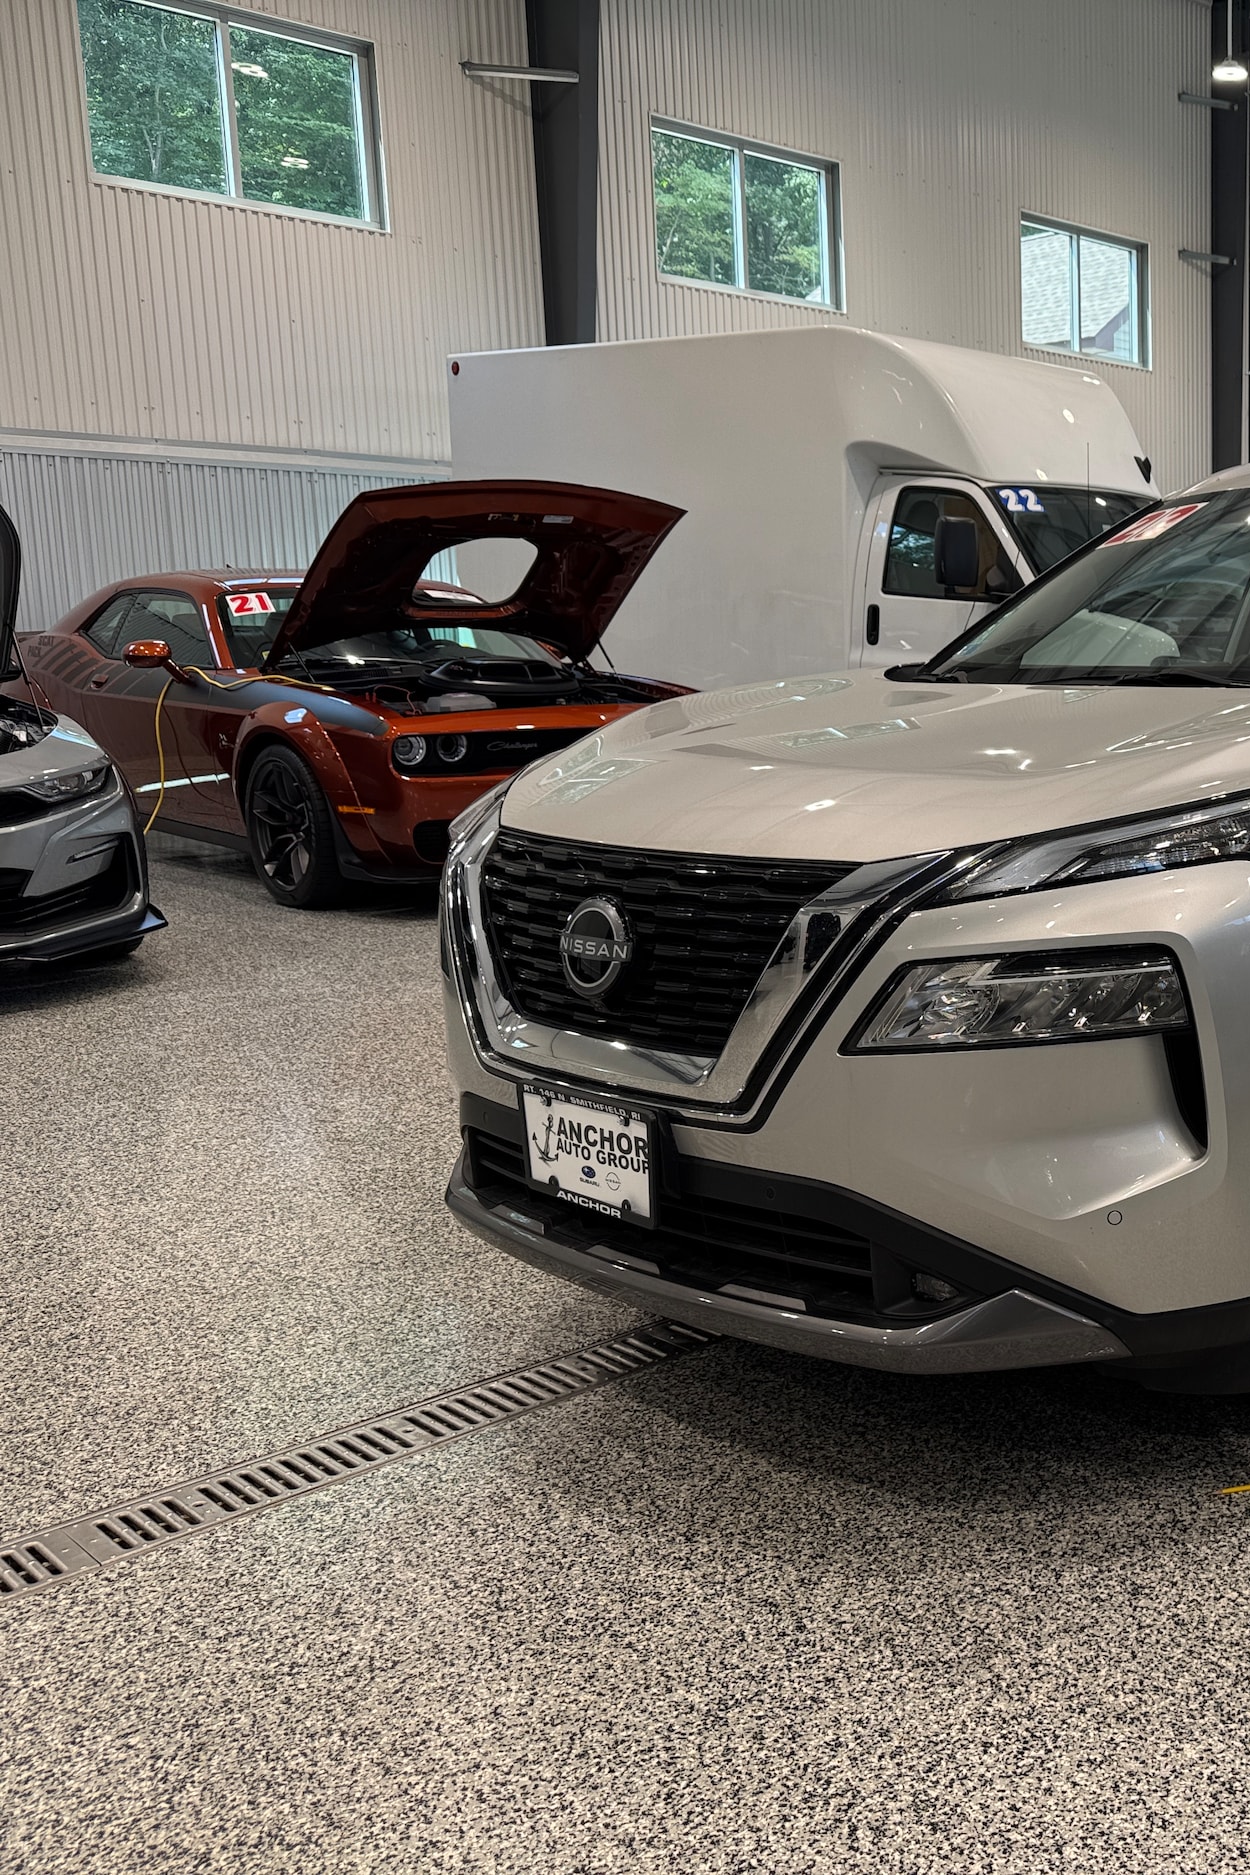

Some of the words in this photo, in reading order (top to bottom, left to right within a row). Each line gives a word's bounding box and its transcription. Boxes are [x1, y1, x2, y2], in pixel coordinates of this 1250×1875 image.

[999, 488, 1045, 512] 22
[229, 594, 269, 613] 21
[560, 935, 628, 959] NISSAN
[523, 1084, 537, 1094] RT.
[540, 1088, 556, 1099] 146
[631, 1111, 641, 1120] RI
[557, 1117, 649, 1160] ANCHOR
[557, 1138, 591, 1161] AUTO
[579, 1177, 600, 1187] SUBARU
[556, 1190, 622, 1219] ANCHOR
